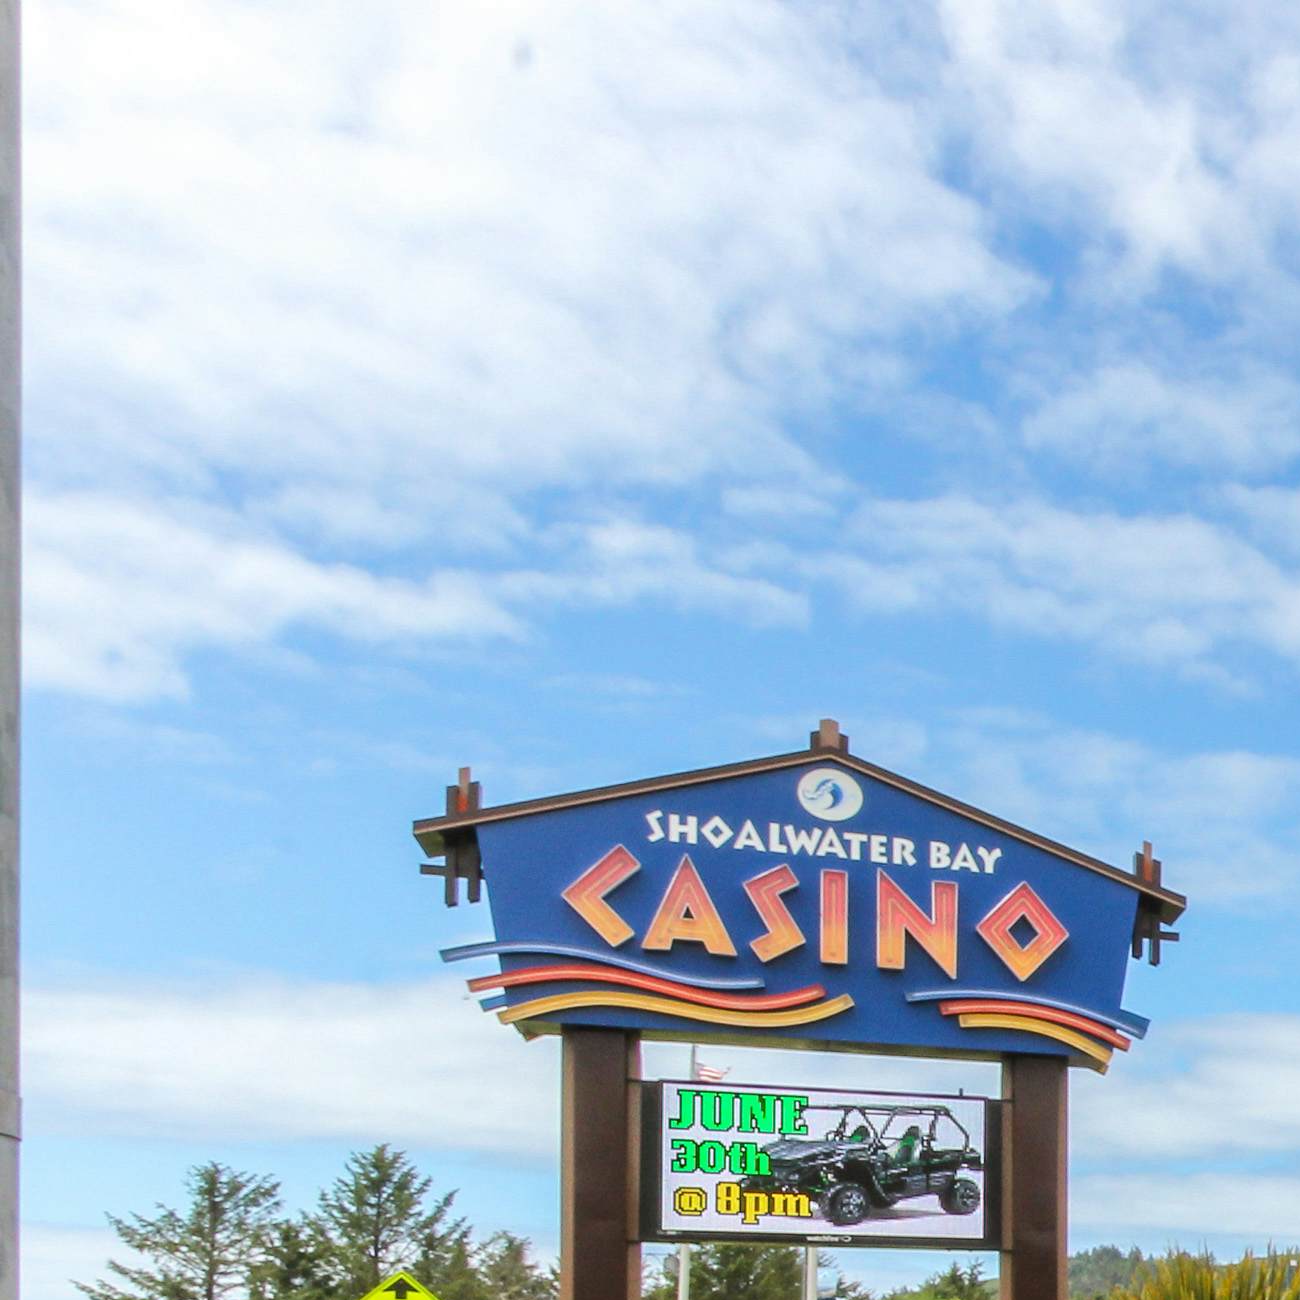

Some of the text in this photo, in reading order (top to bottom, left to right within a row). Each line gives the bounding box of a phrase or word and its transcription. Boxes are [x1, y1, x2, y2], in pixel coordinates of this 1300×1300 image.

[645, 810, 1002, 874] SHOALWATER BAY
[561, 844, 1070, 982] CASINO
[669, 1089, 809, 1135] JUNE
[671, 1138, 772, 1176] 30th
[673, 1181, 812, 1225] @ 8pm
